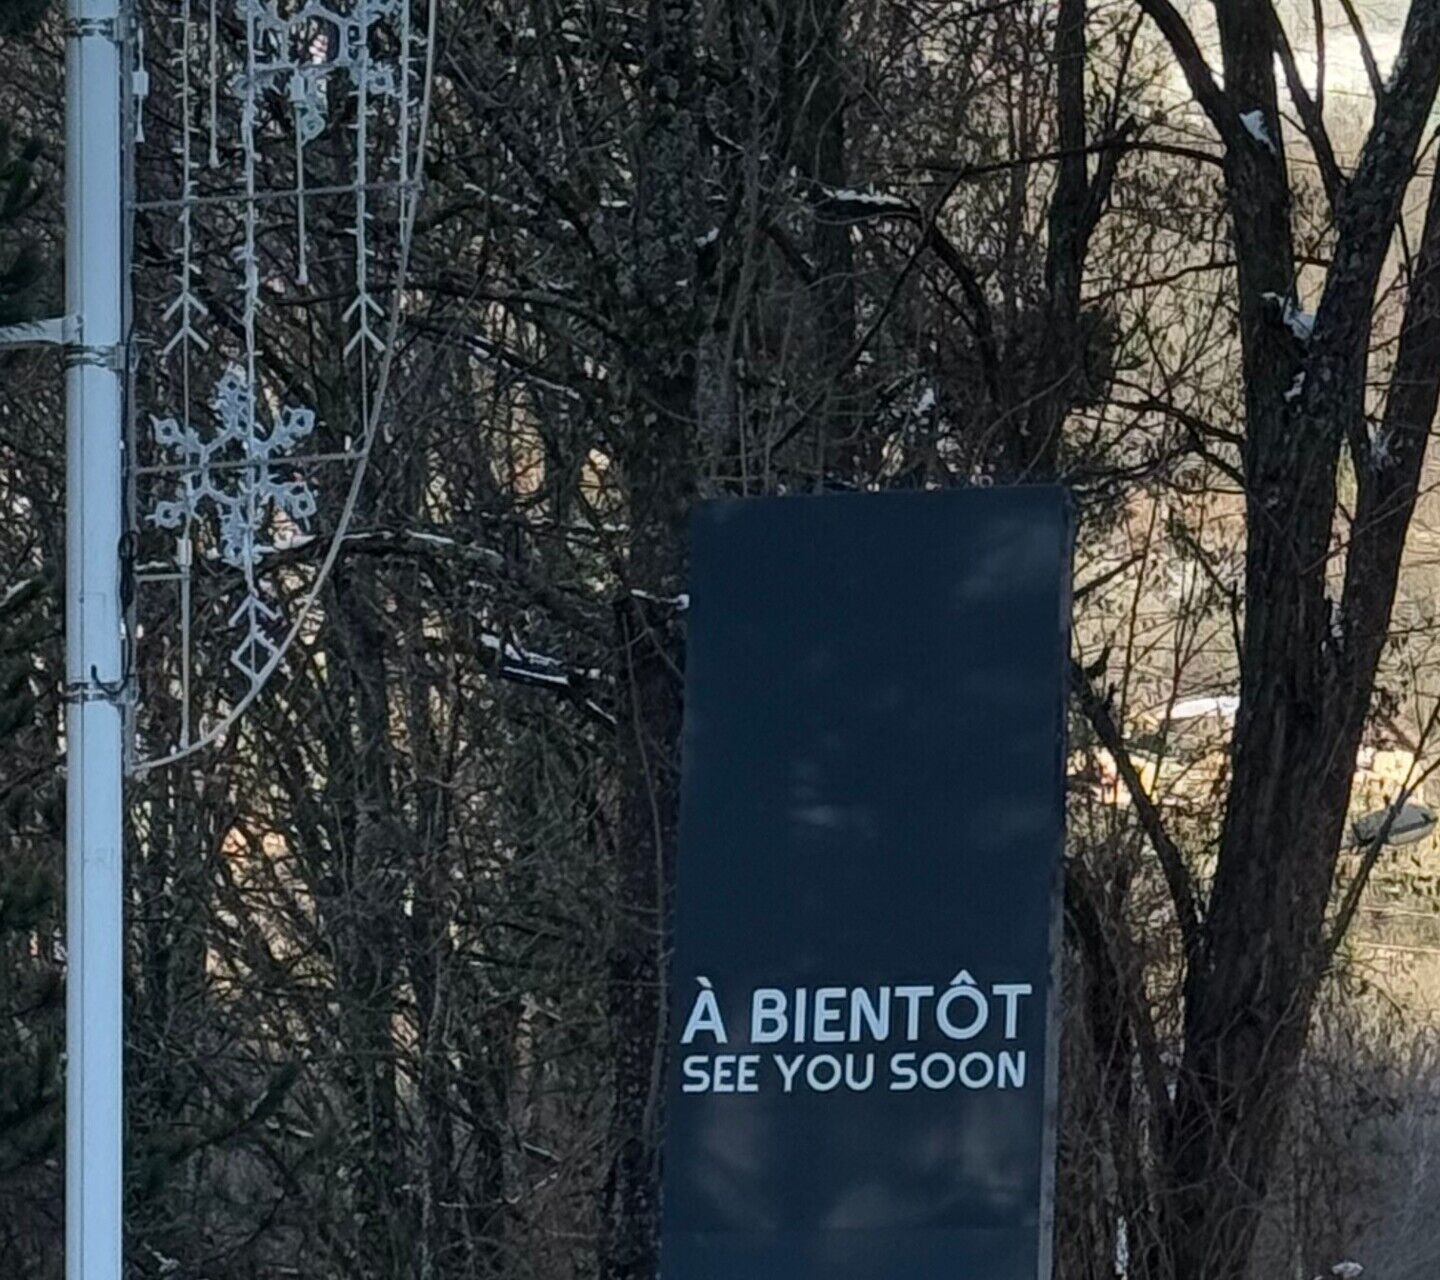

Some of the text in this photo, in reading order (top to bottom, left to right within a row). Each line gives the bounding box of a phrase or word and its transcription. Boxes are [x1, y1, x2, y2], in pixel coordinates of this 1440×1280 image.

[680, 969, 1032, 1044] À BIENTÔT
[682, 1051, 1026, 1093] SEE YOU SOON
